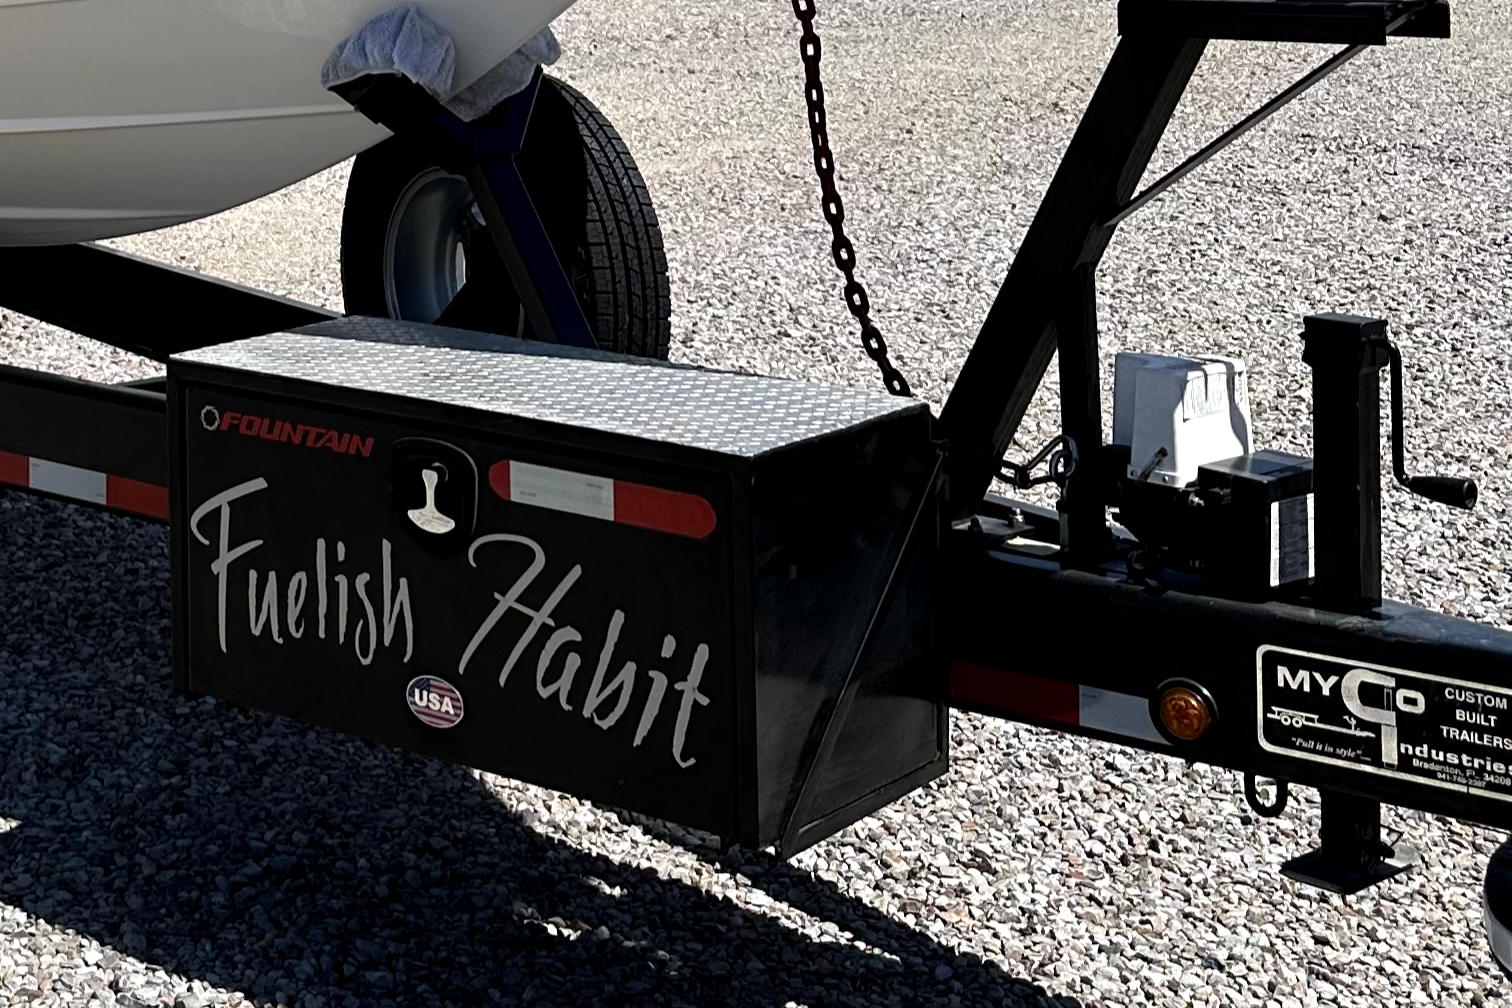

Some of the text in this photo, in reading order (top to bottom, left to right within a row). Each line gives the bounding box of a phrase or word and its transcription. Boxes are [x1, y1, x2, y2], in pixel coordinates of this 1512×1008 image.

[220, 411, 375, 457] FOUNTAIN
[190, 477, 710, 769] Fuelish Habit
[414, 687, 455, 715] USA
[1444, 687, 1508, 710] CUSTOM
[1455, 708, 1498, 727] BUILT
[1439, 724, 1512, 750] TRAILERS
[1482, 772, 1512, 786] 34208
